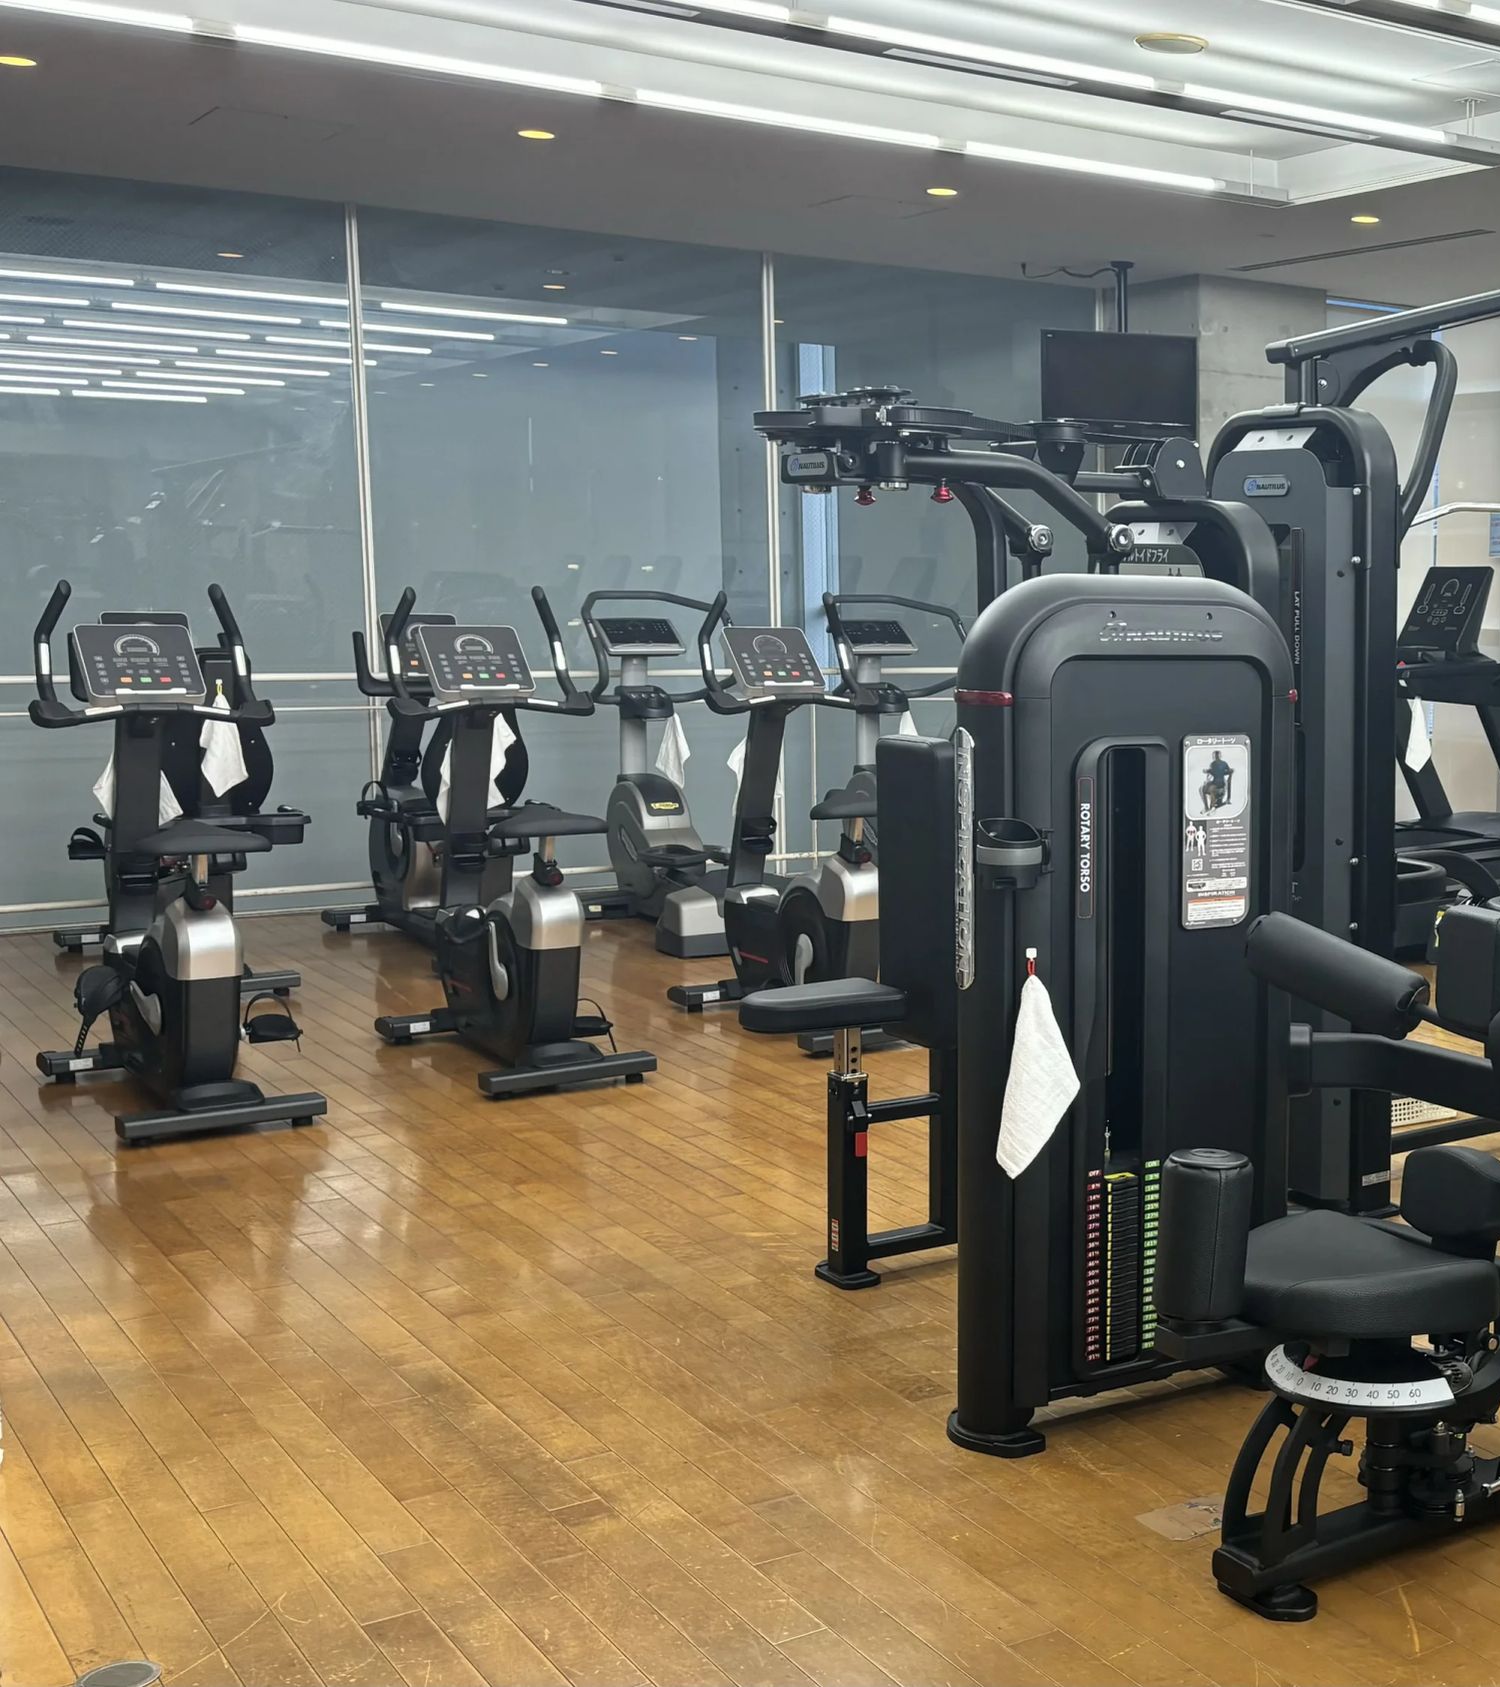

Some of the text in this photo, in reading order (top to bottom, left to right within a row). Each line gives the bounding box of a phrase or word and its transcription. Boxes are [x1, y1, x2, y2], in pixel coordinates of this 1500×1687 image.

[1080, 803, 1091, 893] ROTARY TORSO
[1285, 1370, 1293, 1380] 10
[1296, 1377, 1304, 1386] 0
[1311, 1381, 1322, 1392] 10
[1326, 1386, 1338, 1395] 20
[1345, 1388, 1358, 1398] 30
[1366, 1389, 1379, 1399] 40
[1387, 1389, 1400, 1399] 50
[1408, 1388, 1421, 1398] 60
